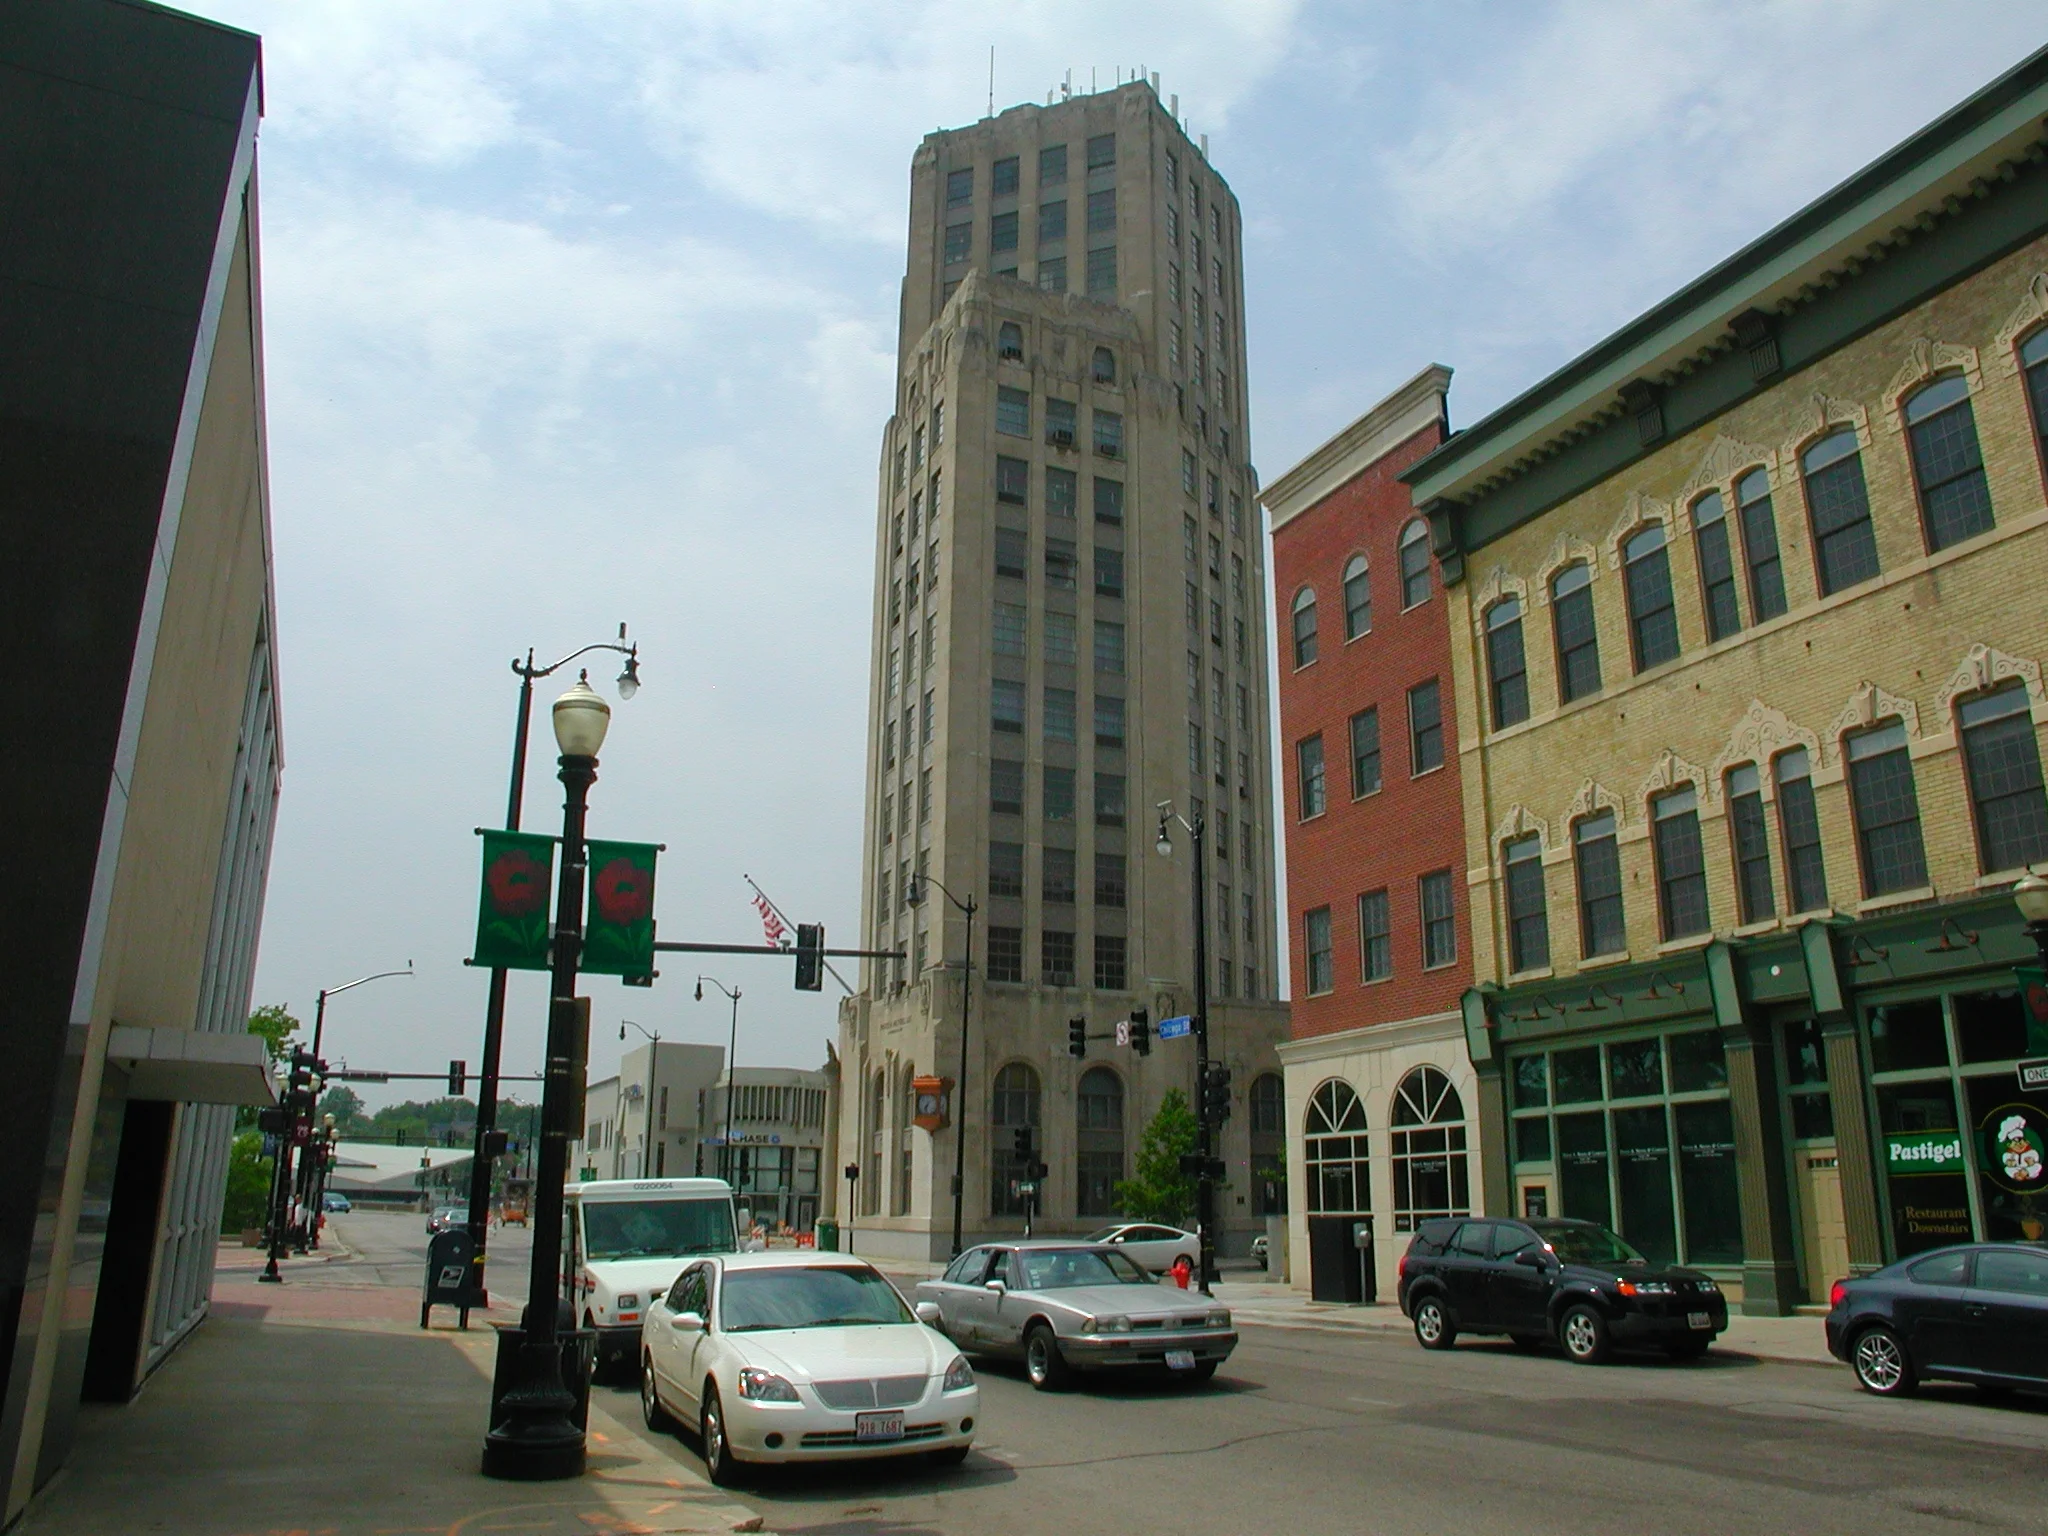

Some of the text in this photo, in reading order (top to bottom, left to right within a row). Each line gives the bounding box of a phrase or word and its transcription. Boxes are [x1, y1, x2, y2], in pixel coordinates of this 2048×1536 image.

[1160, 1023, 1182, 1035] Chicago
[2027, 1066, 2048, 1081] ONE
[1889, 1139, 1961, 1163] Pastigel
[1905, 1206, 1967, 1219] Restaurant
[1908, 1220, 1969, 1233] Downstairs
